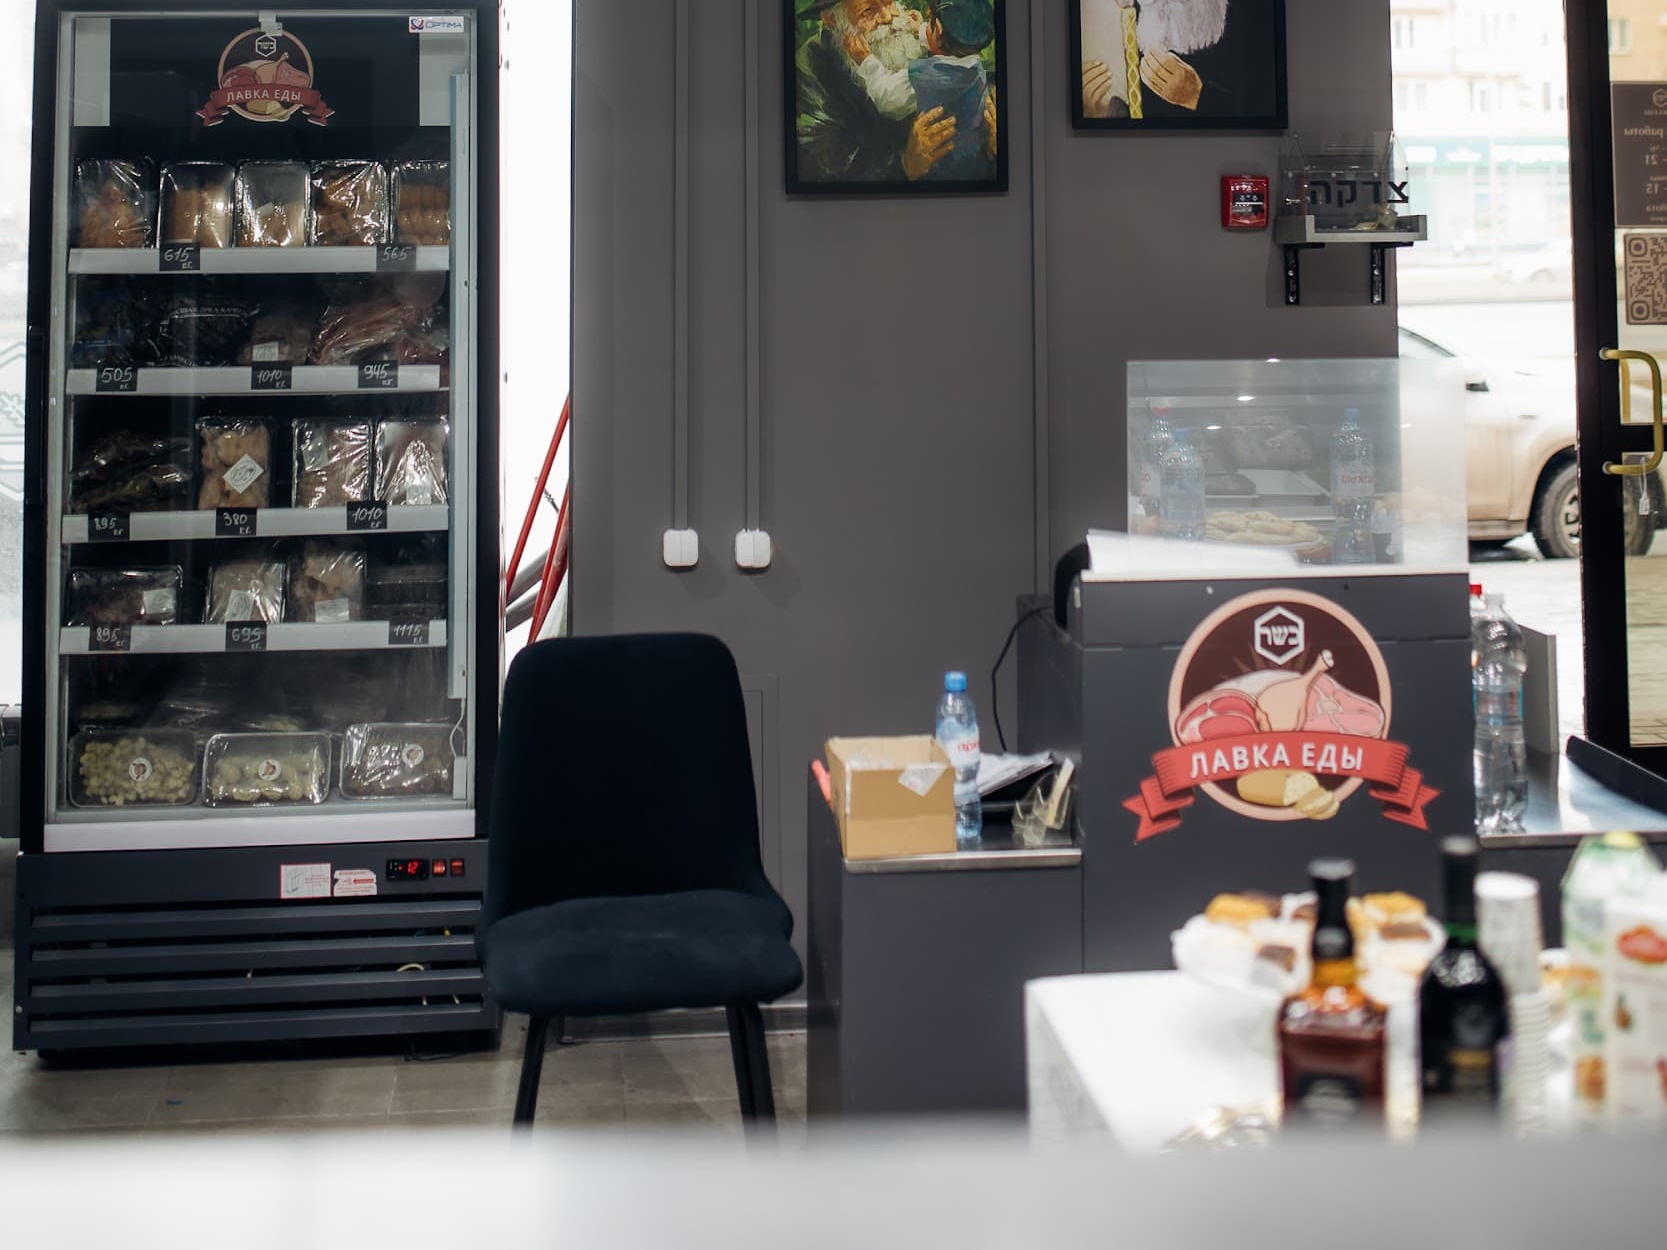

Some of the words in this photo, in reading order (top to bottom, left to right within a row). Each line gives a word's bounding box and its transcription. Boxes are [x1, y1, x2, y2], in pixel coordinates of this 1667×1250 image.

[226, 89, 270, 102] ЛАВКА
[274, 89, 301, 102] ЕДЫ
[164, 247, 194, 262] 615
[381, 246, 412, 261] 565
[101, 367, 132, 383] 505
[257, 369, 282, 384] 1010
[363, 363, 391, 380] 945
[223, 512, 248, 526] 380
[352, 506, 383, 523] 1010
[96, 627, 120, 642] 895
[231, 626, 264, 643] 695
[393, 623, 423, 637] 1115
[1259, 624, 1300, 646] כשר
[1189, 742, 1291, 779] ЛАВКА
[1301, 741, 1363, 774] ЕДЫ
